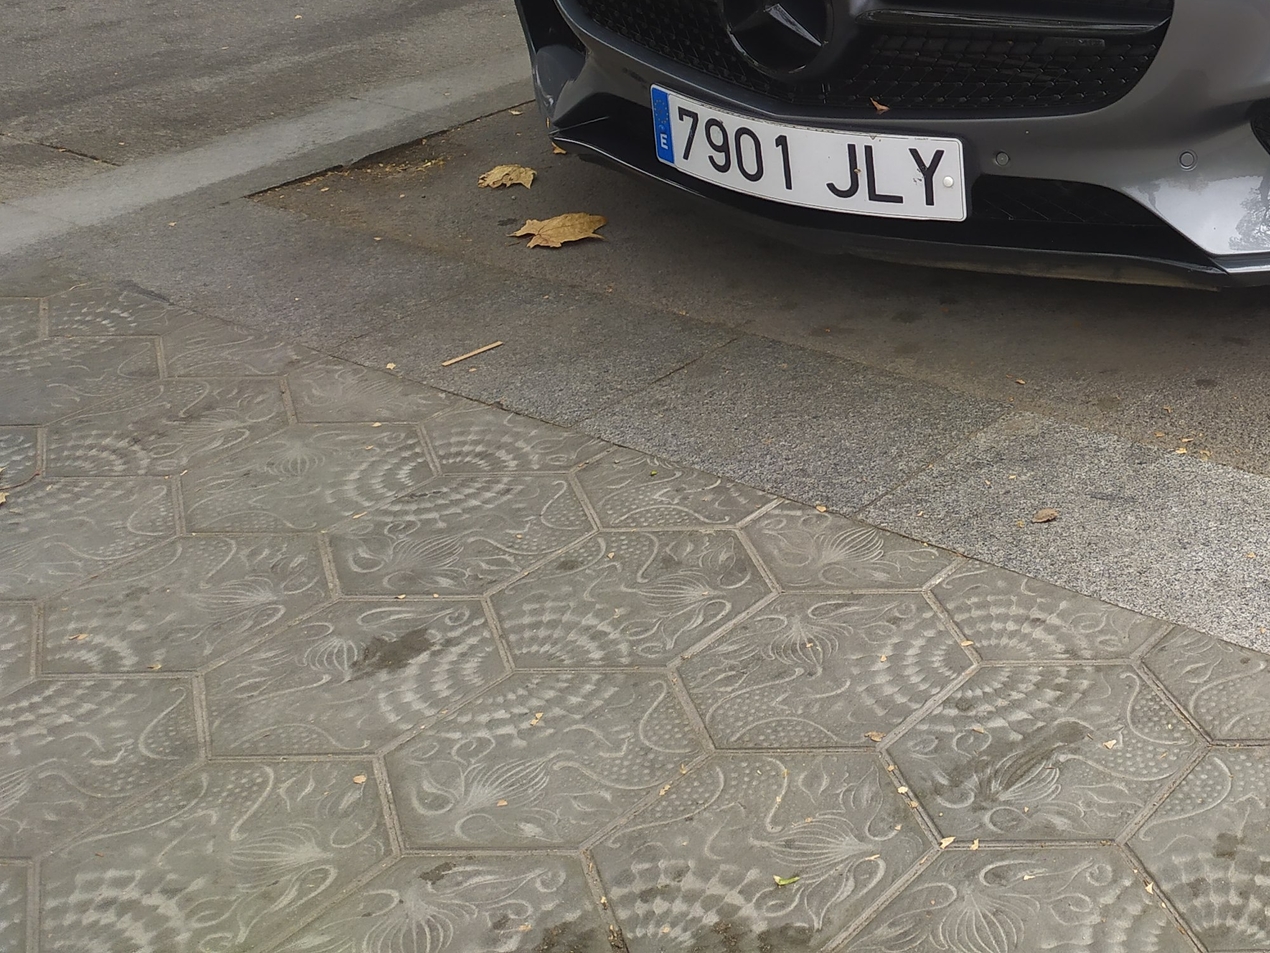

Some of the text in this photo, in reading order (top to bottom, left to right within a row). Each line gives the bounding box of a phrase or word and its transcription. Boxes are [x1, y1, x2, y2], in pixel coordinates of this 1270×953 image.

[660, 133, 668, 149] E
[677, 106, 945, 206] 7901 JLY
